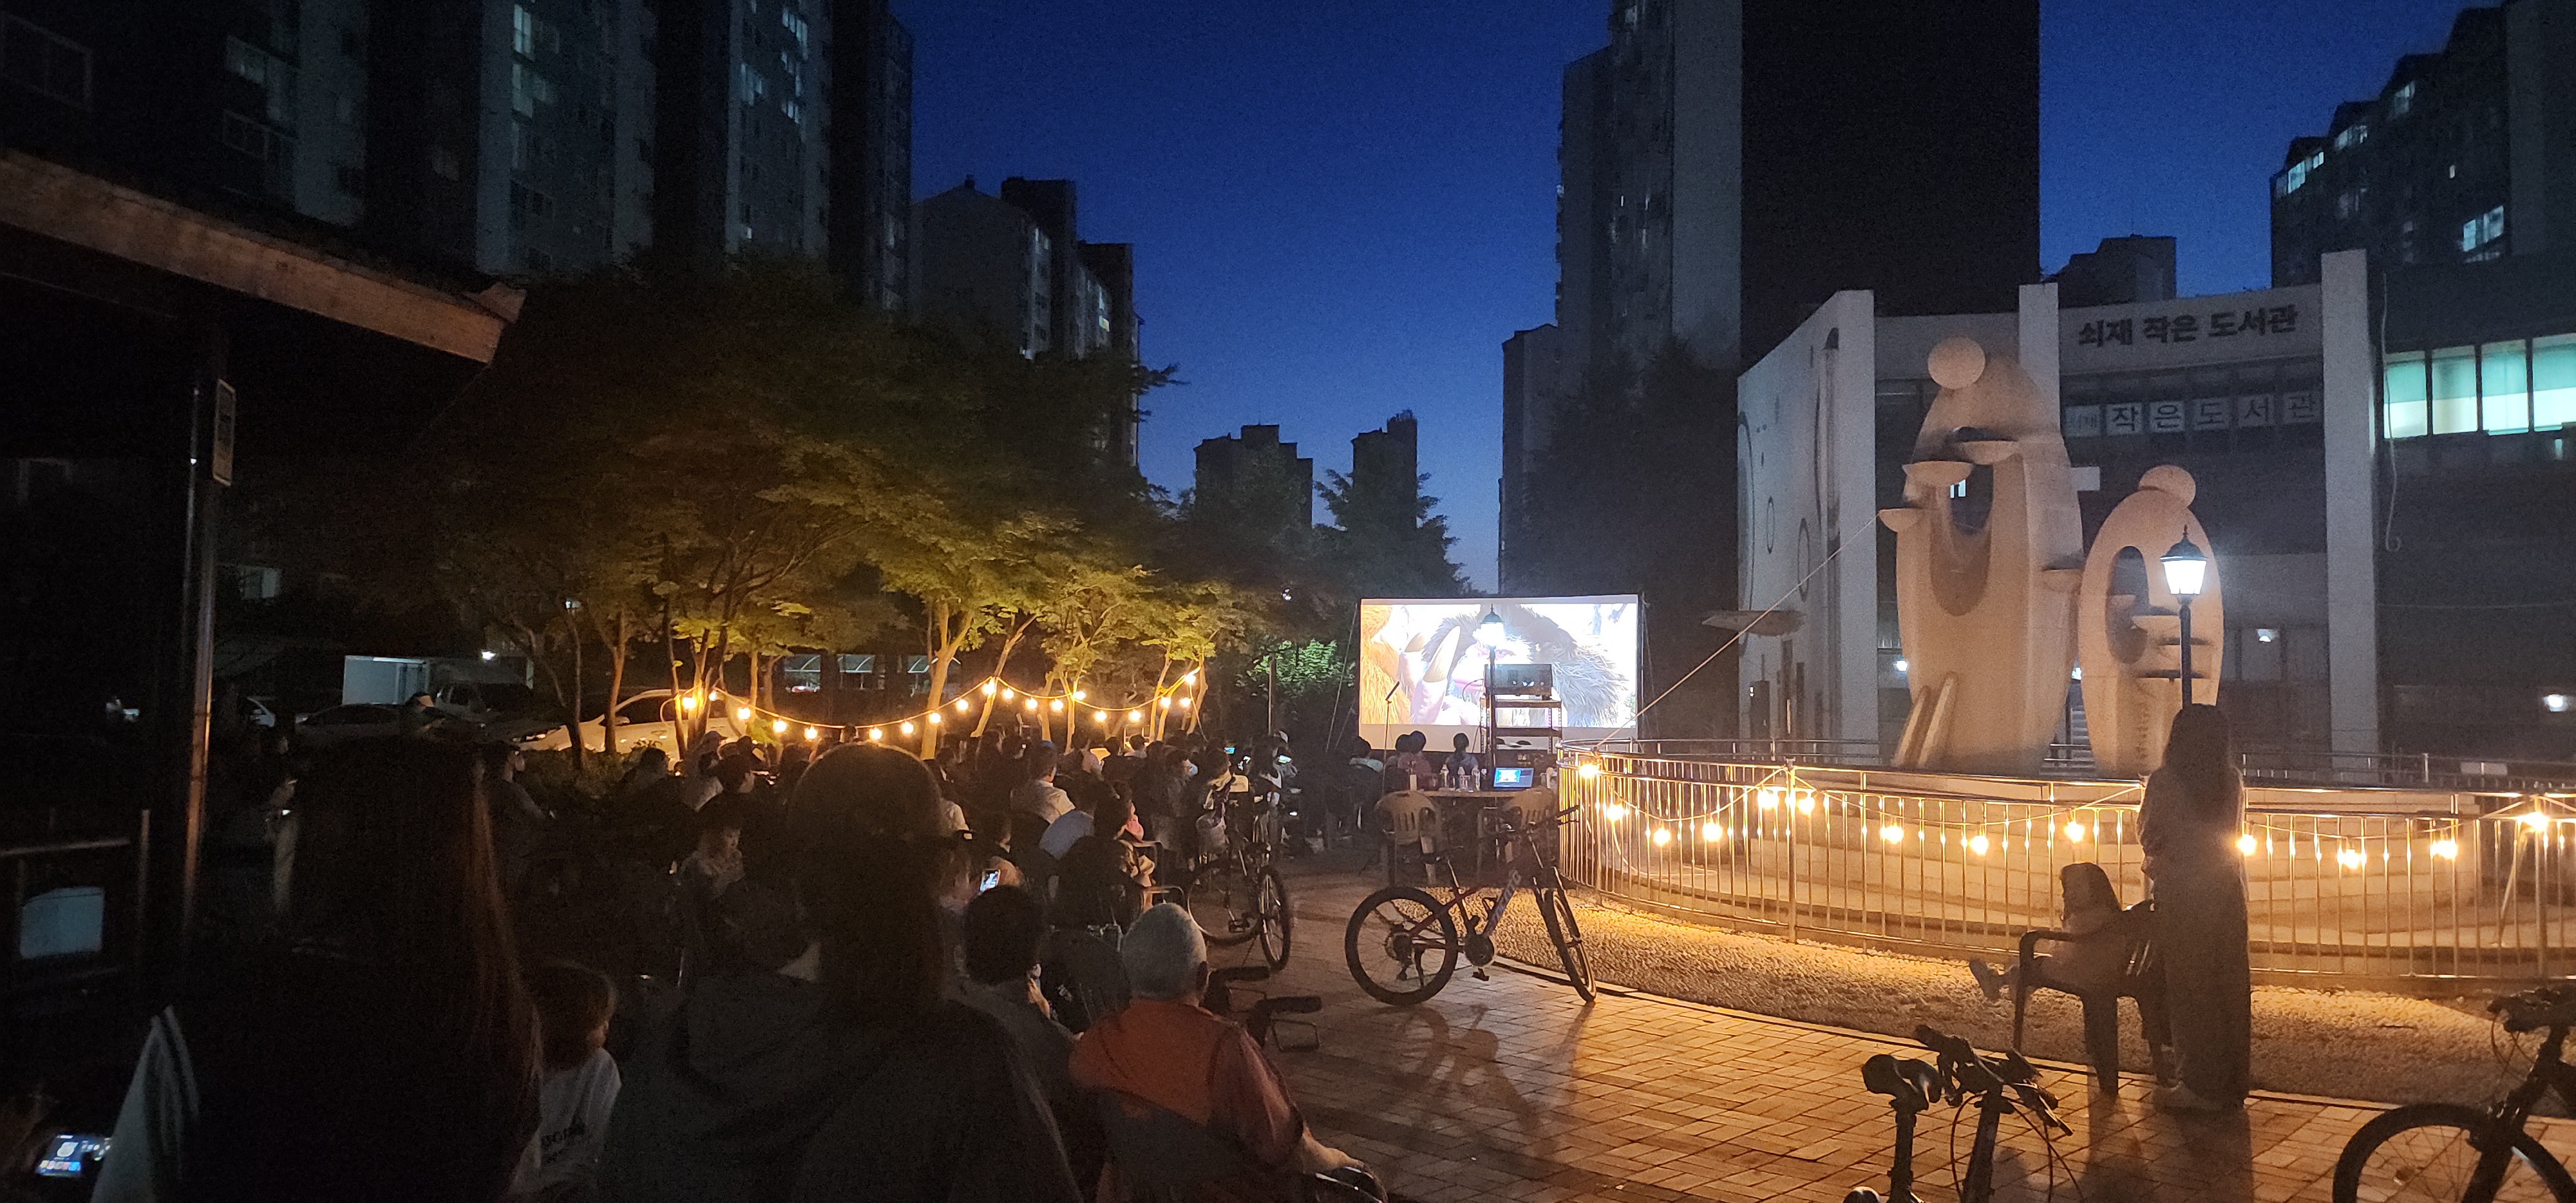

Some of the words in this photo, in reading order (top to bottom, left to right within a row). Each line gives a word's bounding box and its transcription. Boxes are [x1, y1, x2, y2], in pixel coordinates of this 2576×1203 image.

[2078, 317, 2134, 348] 쇠재
[2143, 313, 2199, 344] 작은
[2208, 303, 2300, 336] 도서관
[2112, 393, 2316, 432] 작은도서관
